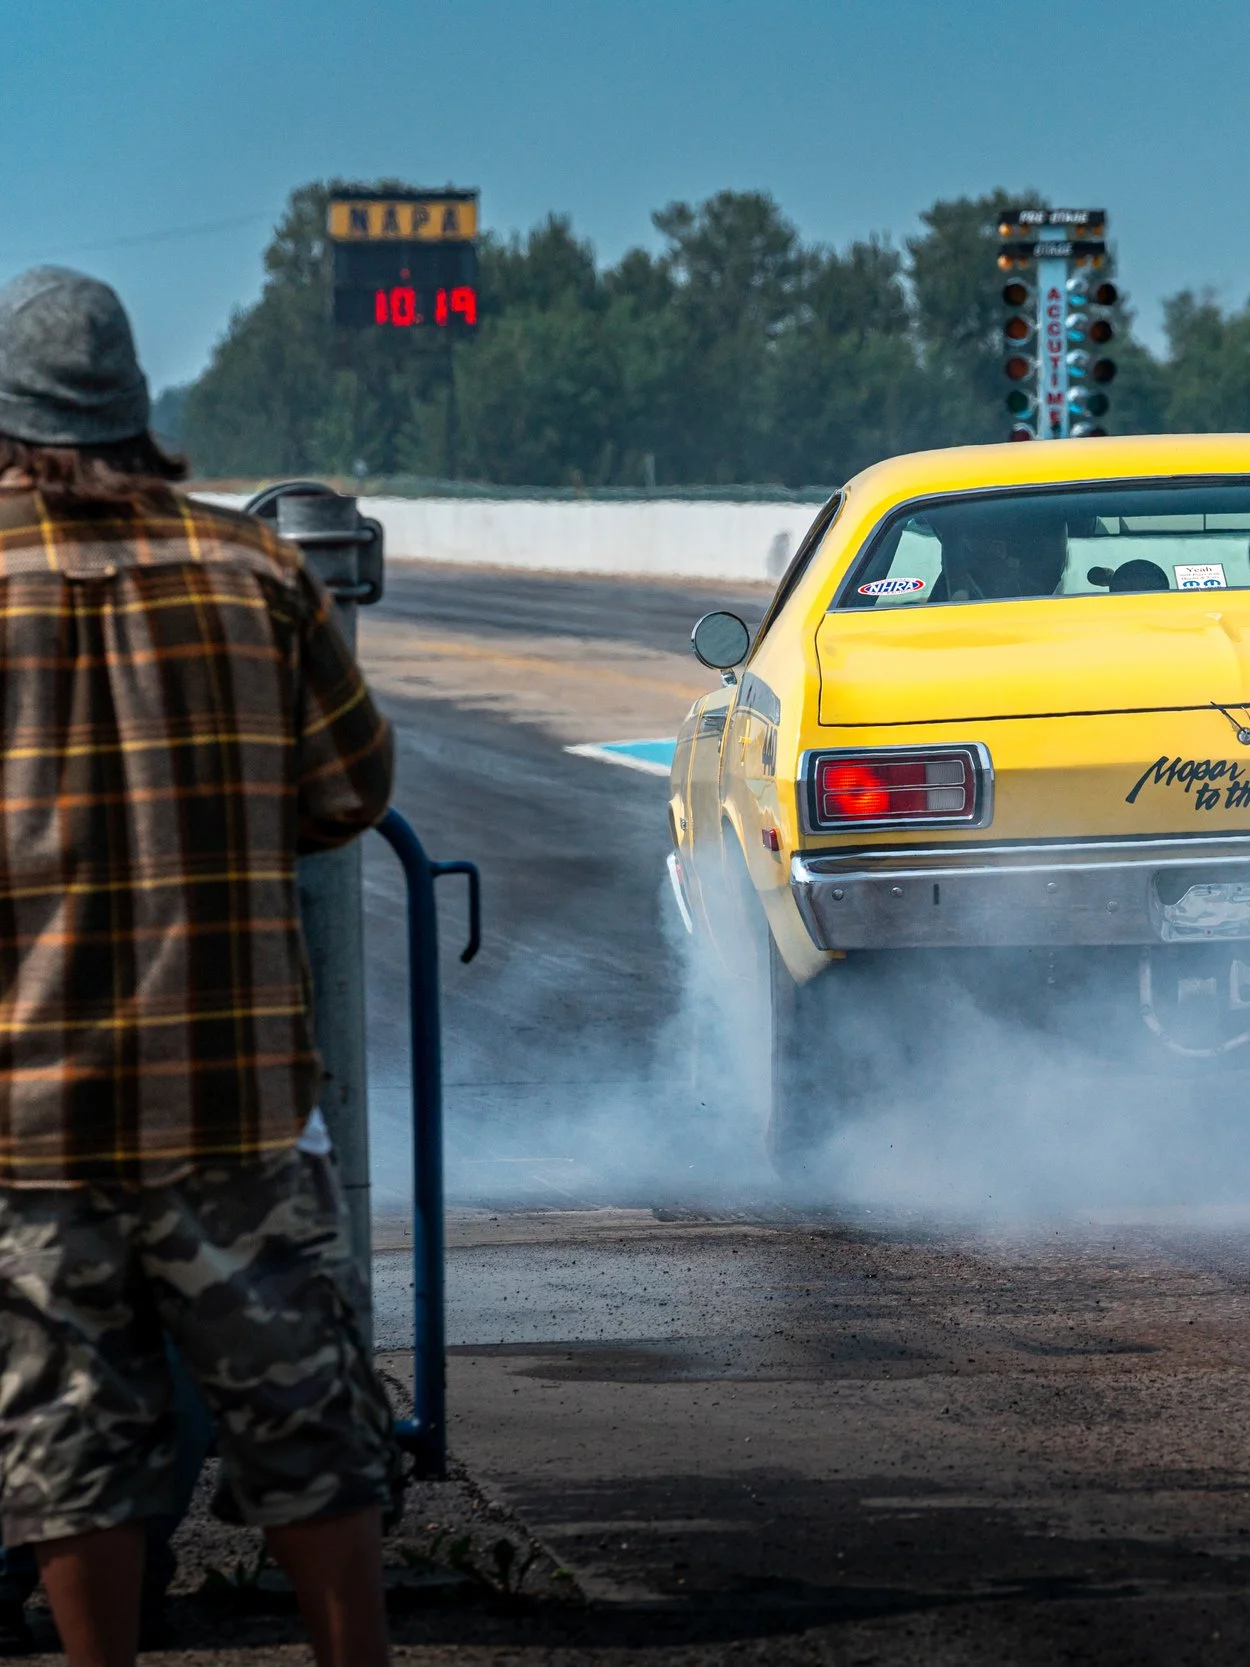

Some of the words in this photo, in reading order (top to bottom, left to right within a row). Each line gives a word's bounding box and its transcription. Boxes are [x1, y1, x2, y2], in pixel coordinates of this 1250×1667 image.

[349, 204, 460, 236] NAPA
[870, 580, 914, 593] NHRA
[1125, 755, 1246, 805] Mopar
[1195, 782, 1222, 811] to
